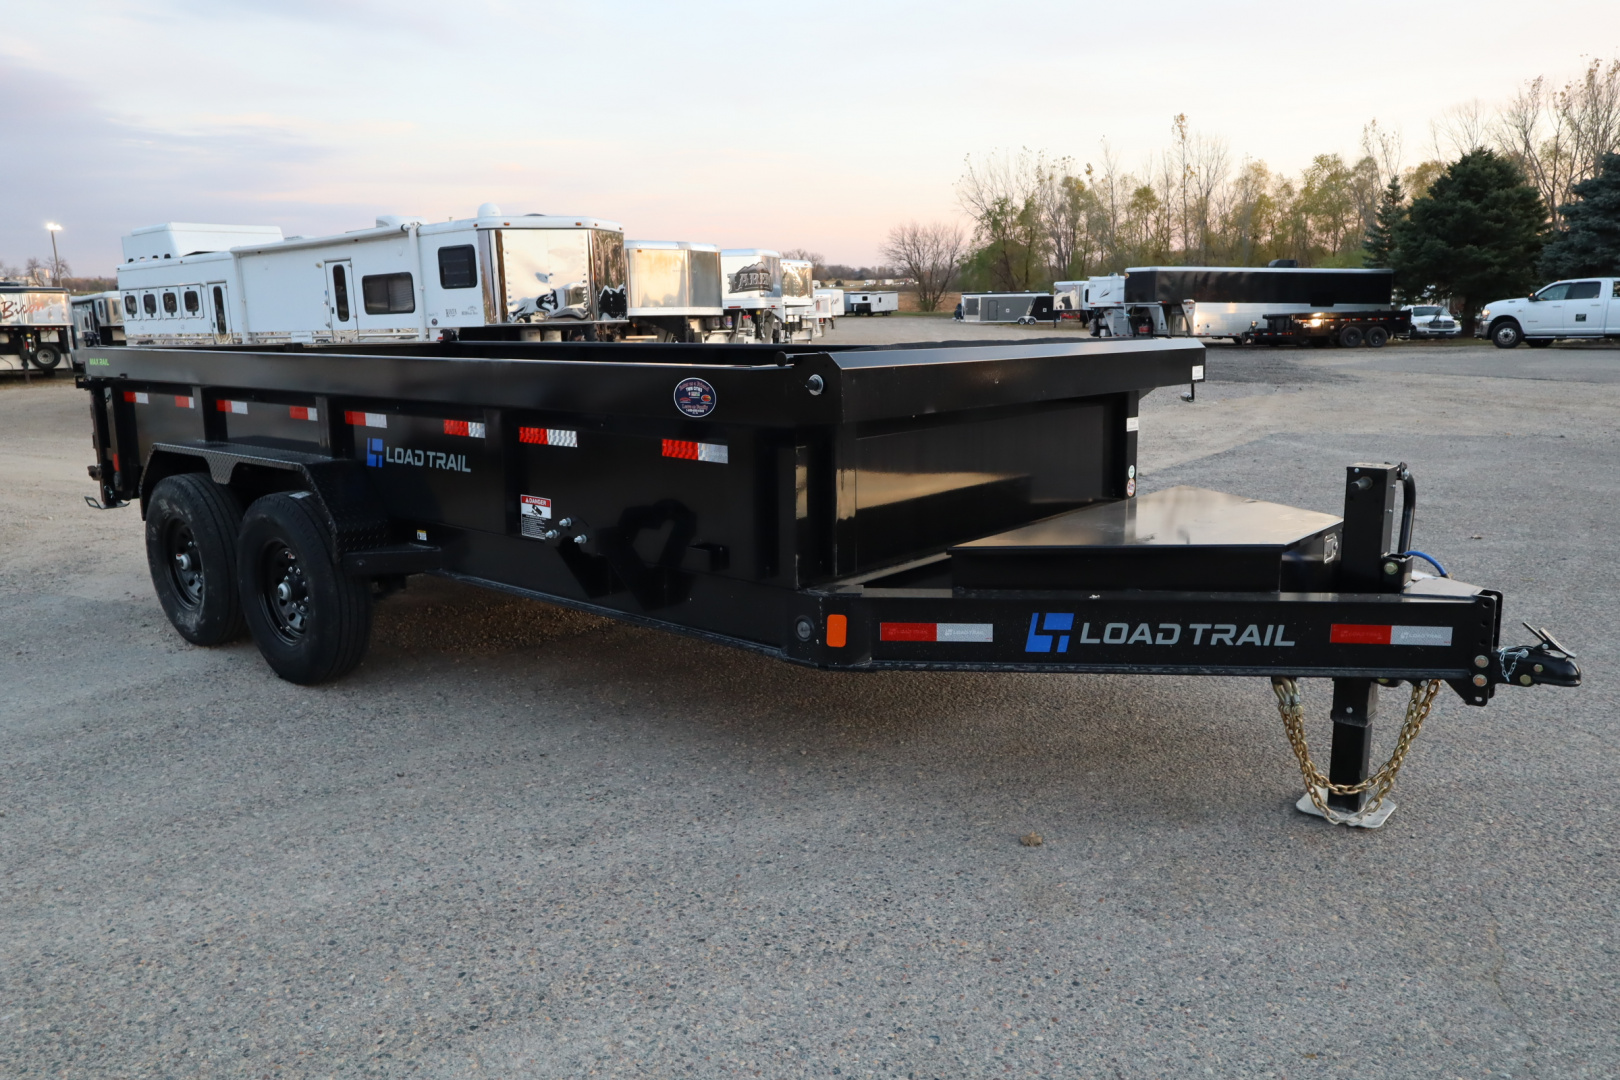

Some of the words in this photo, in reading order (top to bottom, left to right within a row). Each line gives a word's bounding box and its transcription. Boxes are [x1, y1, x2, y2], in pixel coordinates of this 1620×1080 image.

[1, 300, 46, 319] Bison
[386, 446, 425, 467] LOAD
[426, 451, 471, 473] TRAIL
[528, 498, 547, 506] DANGER
[1080, 622, 1182, 645] LOAD
[1189, 623, 1296, 647] TRAIL
